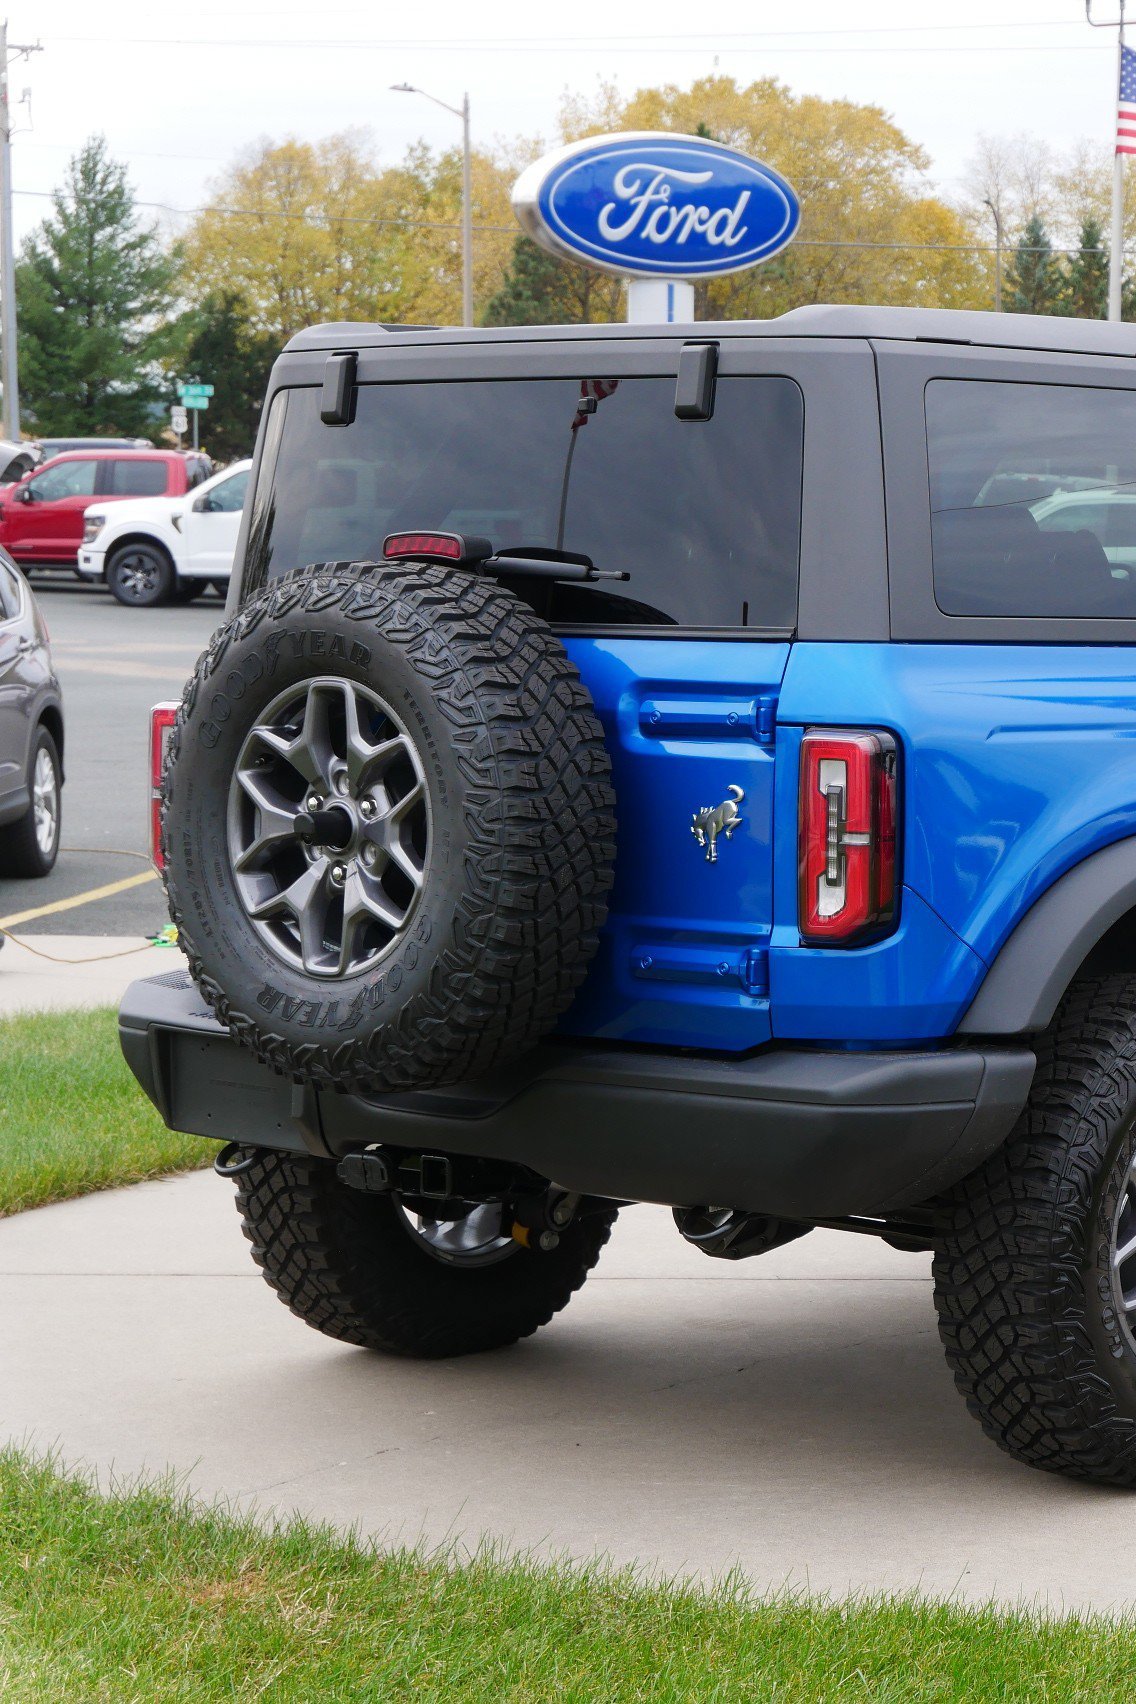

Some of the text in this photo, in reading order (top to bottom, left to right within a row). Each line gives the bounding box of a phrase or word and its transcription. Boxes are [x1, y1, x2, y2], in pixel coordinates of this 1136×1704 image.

[598, 162, 752, 247] Ford
[199, 627, 372, 749] GOODYEAR
[403, 687, 449, 810] TERRITORY
[256, 913, 433, 1032] GOODYEAR
